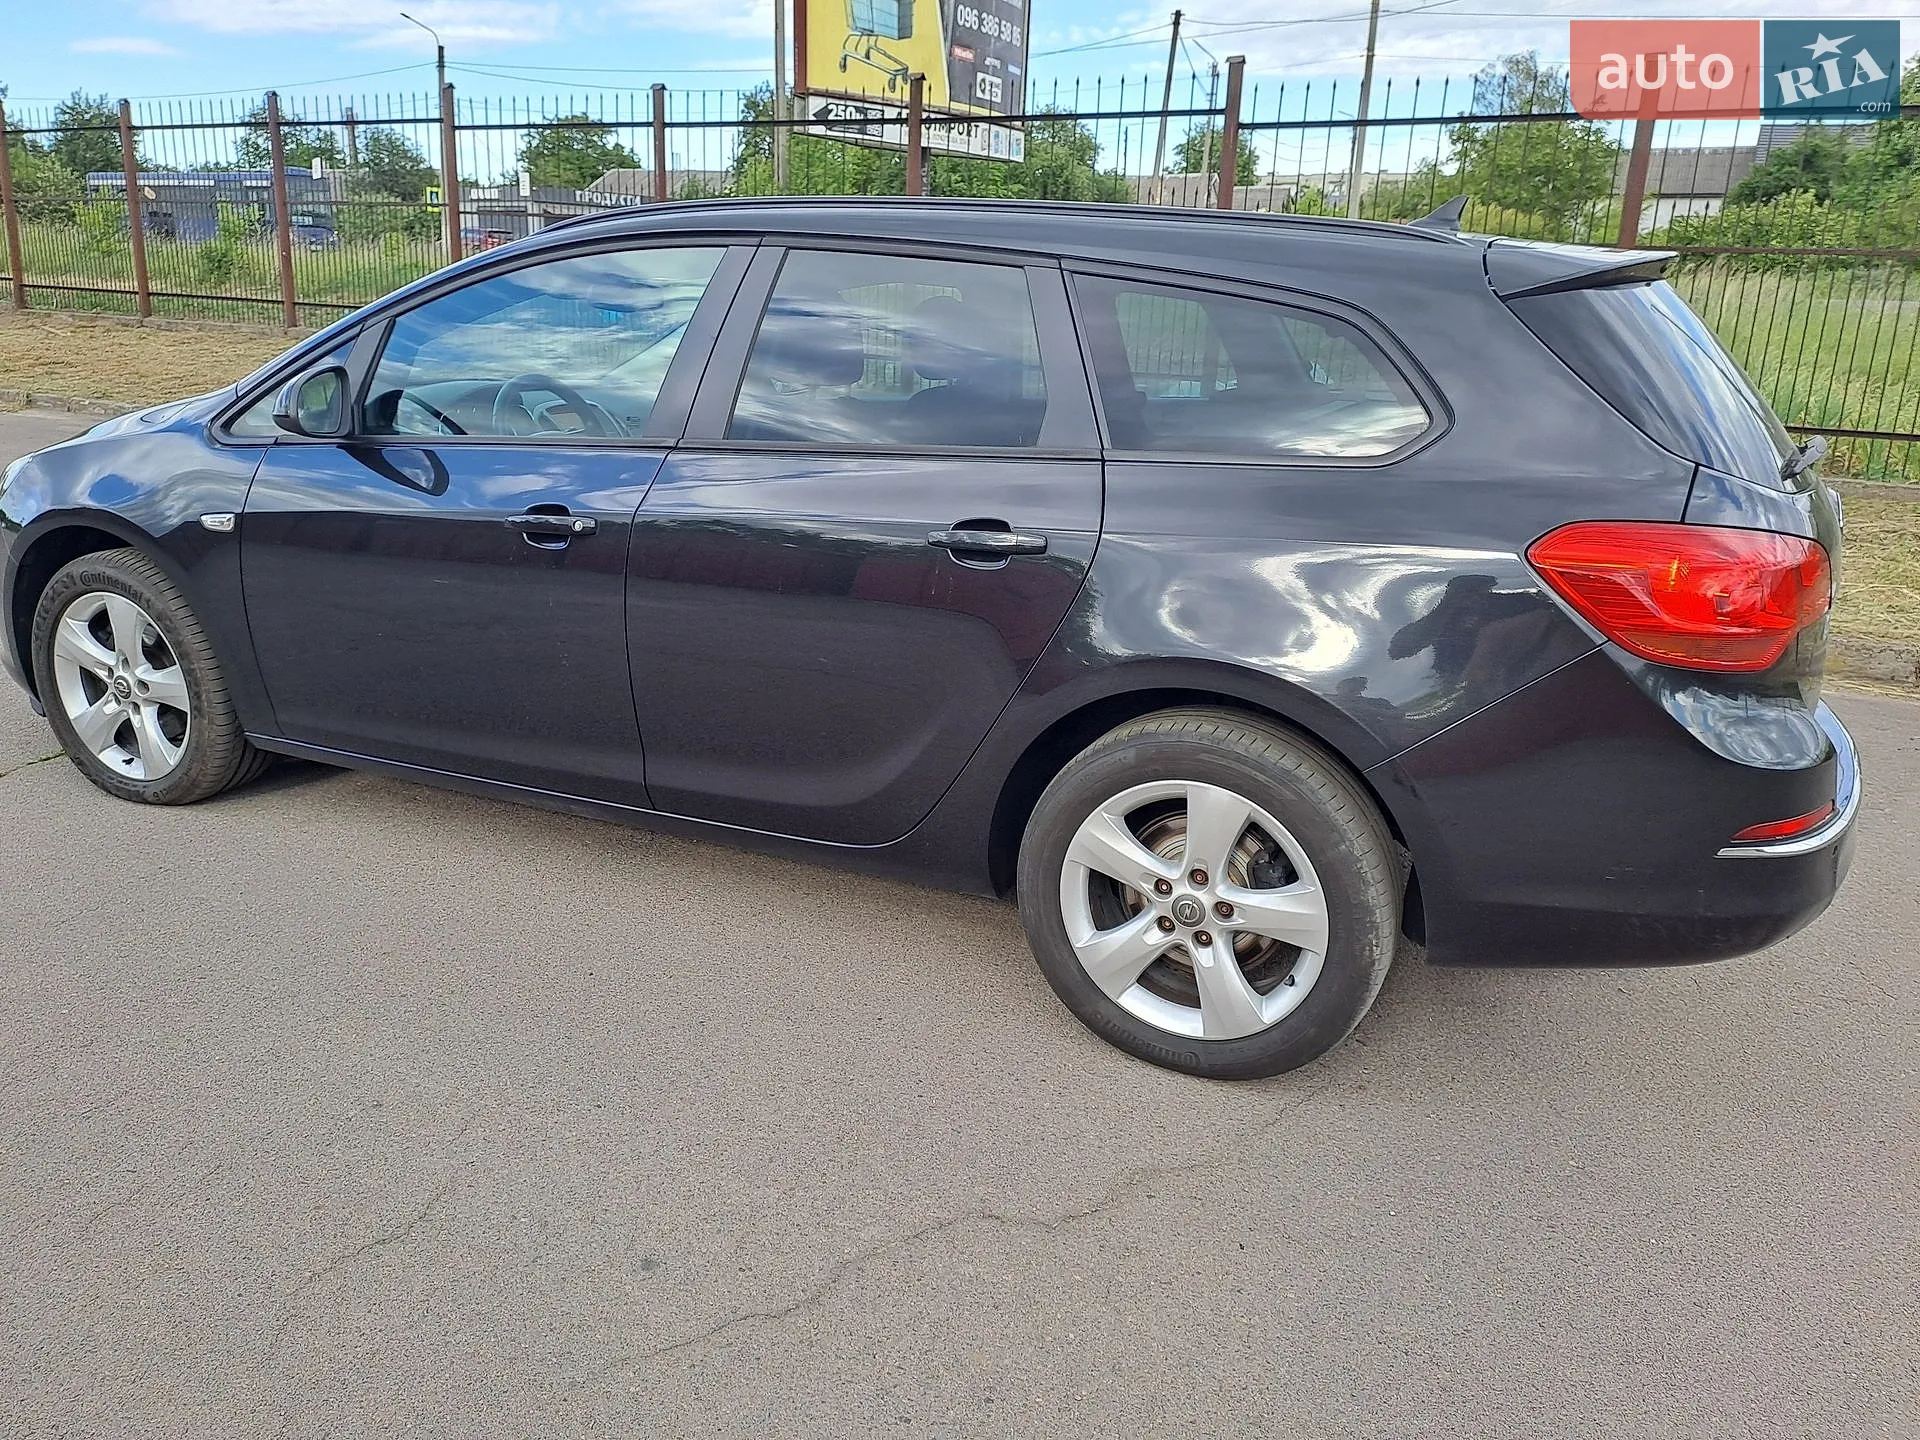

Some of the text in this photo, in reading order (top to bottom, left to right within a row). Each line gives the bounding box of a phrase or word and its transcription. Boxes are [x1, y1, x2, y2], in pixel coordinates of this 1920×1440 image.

[957, 4, 979, 30] 096
[981, 12, 1000, 37] 386
[1000, 20, 1012, 42] 58
[80, 571, 143, 602] Continental
